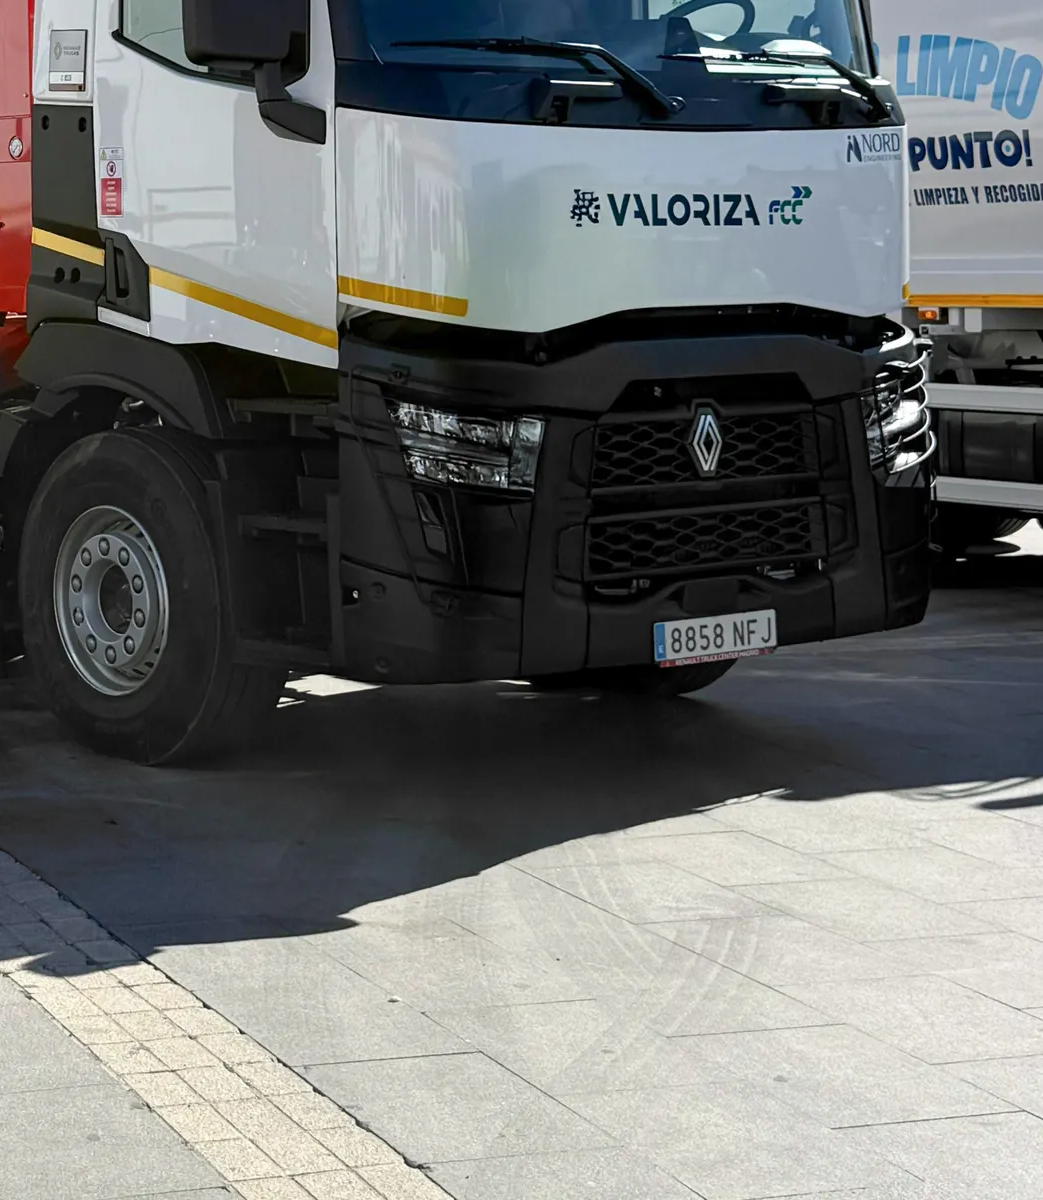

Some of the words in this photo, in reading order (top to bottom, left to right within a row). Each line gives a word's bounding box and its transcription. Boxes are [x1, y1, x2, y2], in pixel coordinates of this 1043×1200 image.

[896, 34, 1043, 120] LIMPIO
[861, 132, 900, 153] NORD
[908, 129, 1033, 172] PUNTO!
[607, 194, 760, 226] VALORIZA
[769, 200, 803, 225] FCC
[913, 186, 970, 206] LIMPIEZA
[971, 185, 980, 204] Y
[671, 623, 724, 654] 8858
[733, 617, 771, 647] NFJ
